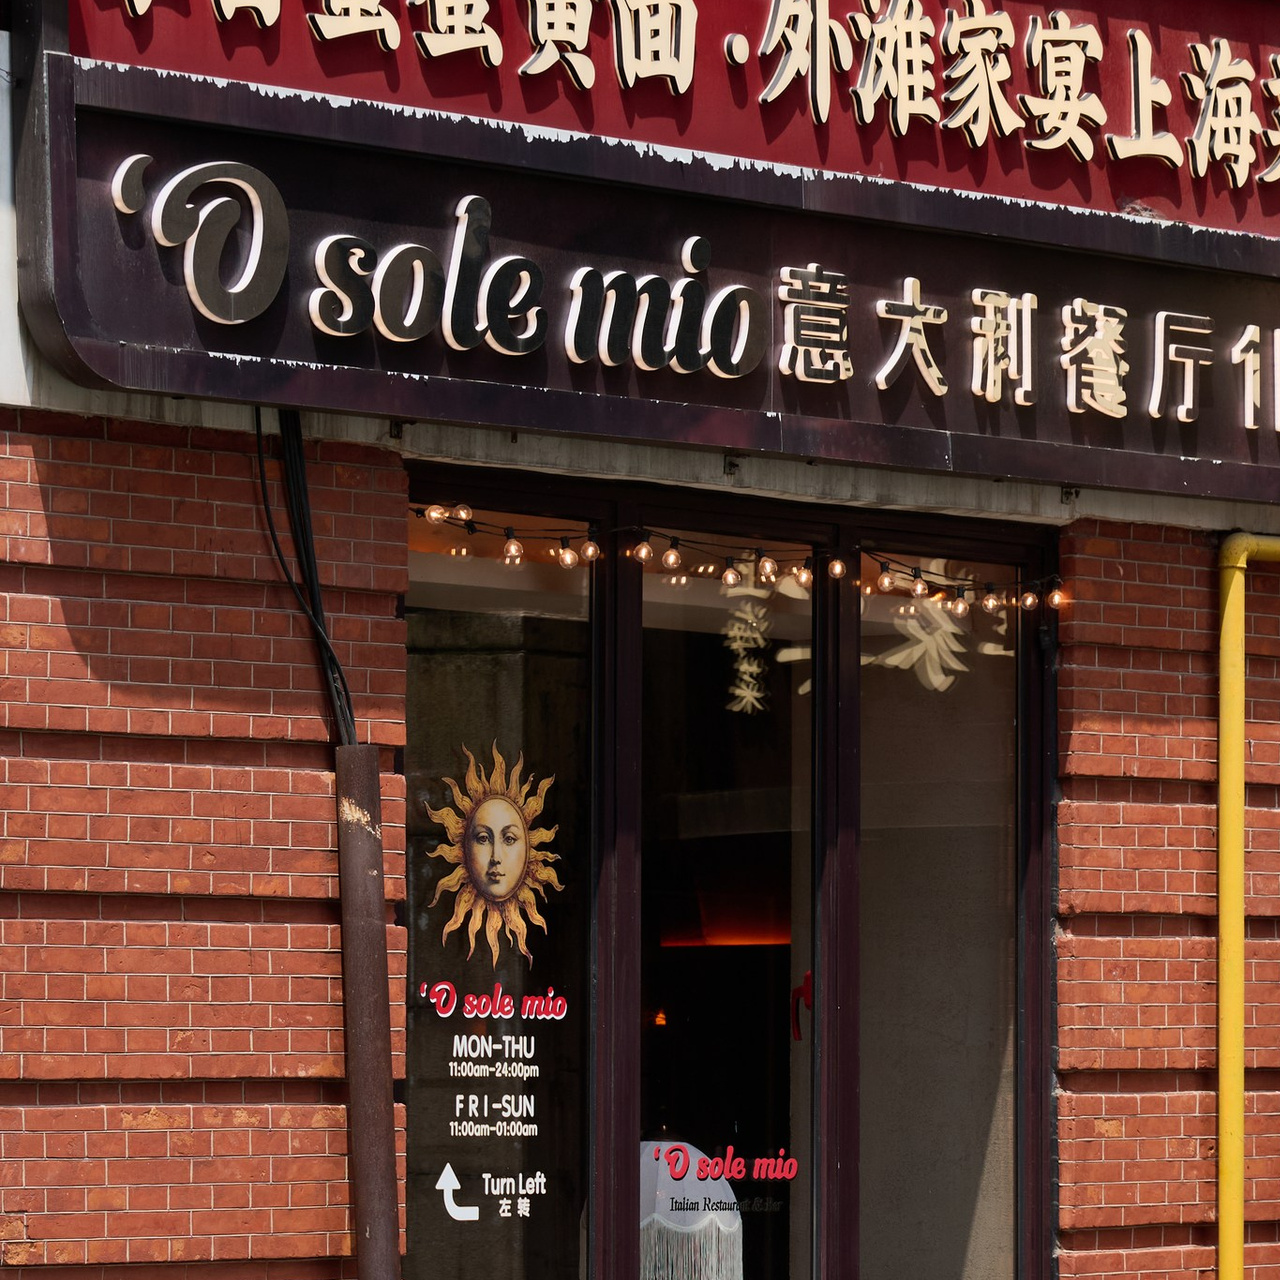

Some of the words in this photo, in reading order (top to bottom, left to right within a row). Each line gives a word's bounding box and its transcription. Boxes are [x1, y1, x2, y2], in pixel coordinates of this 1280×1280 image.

[308, 194, 549, 356] sole
[564, 235, 767, 379] mio
[462, 982, 515, 1019] sole
[521, 986, 568, 1020] mio
[452, 1034, 535, 1059] MON-THU
[448, 1061, 540, 1081] 11:00am-24:00pm
[449, 1121, 538, 1137] 11:00am-01:00am
[696, 1145, 747, 1181] sole
[752, 1148, 799, 1181] mio
[482, 1173, 516, 1196] Turn
[518, 1171, 547, 1196] Left
[498, 1197, 531, 1218] 左转
[669, 1196, 700, 1212] Italian
